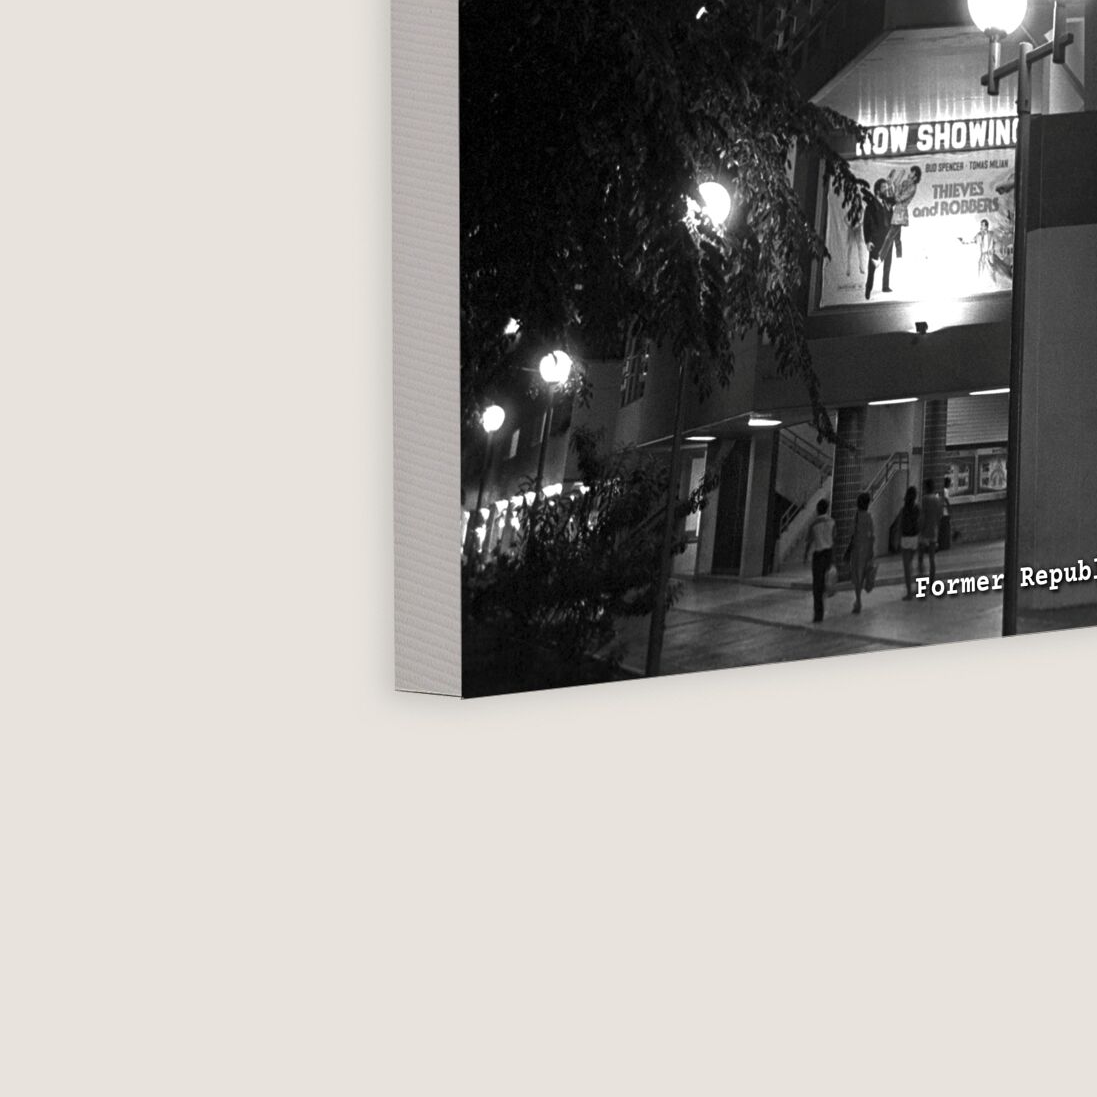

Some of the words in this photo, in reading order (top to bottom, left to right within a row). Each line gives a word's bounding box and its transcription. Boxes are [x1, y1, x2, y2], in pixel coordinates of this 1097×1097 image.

[938, 161, 964, 172] SPENCER
[969, 160, 988, 170] TOMAS
[932, 181, 984, 200] THIEVES
[912, 201, 939, 218] and
[940, 197, 1000, 216] ROBBERS
